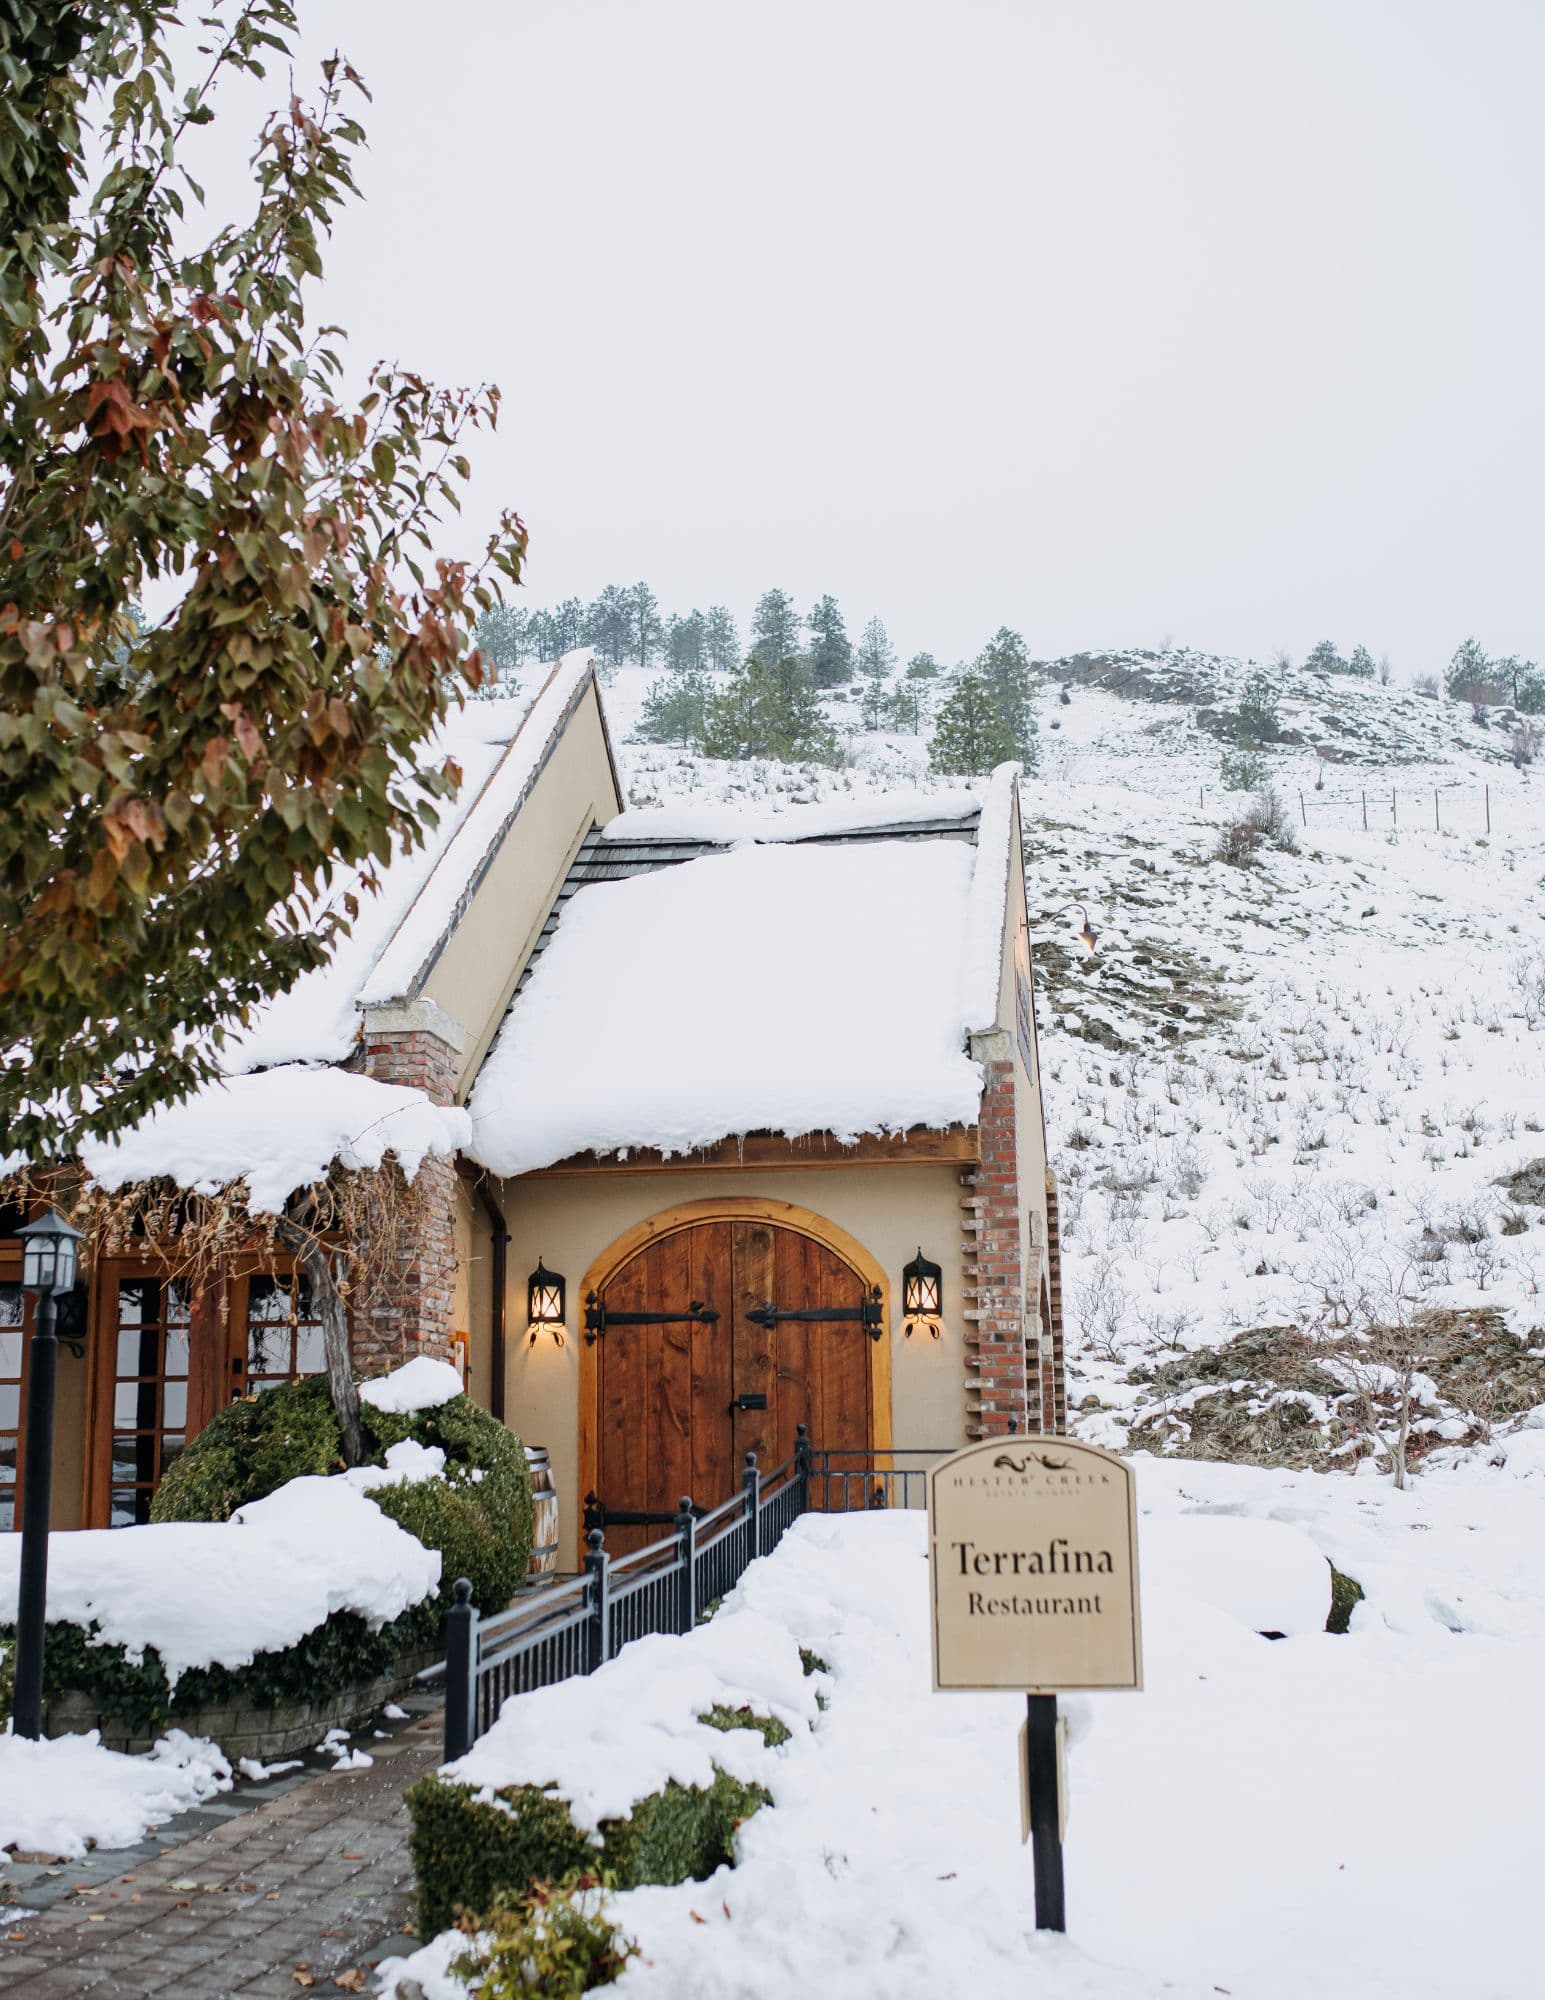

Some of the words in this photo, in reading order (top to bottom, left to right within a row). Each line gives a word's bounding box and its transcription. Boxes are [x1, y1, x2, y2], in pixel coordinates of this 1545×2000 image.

[1045, 1474, 1109, 1486] CREEK
[951, 1539, 1114, 1577] Terrafina
[968, 1592, 1102, 1616] Restaurant
